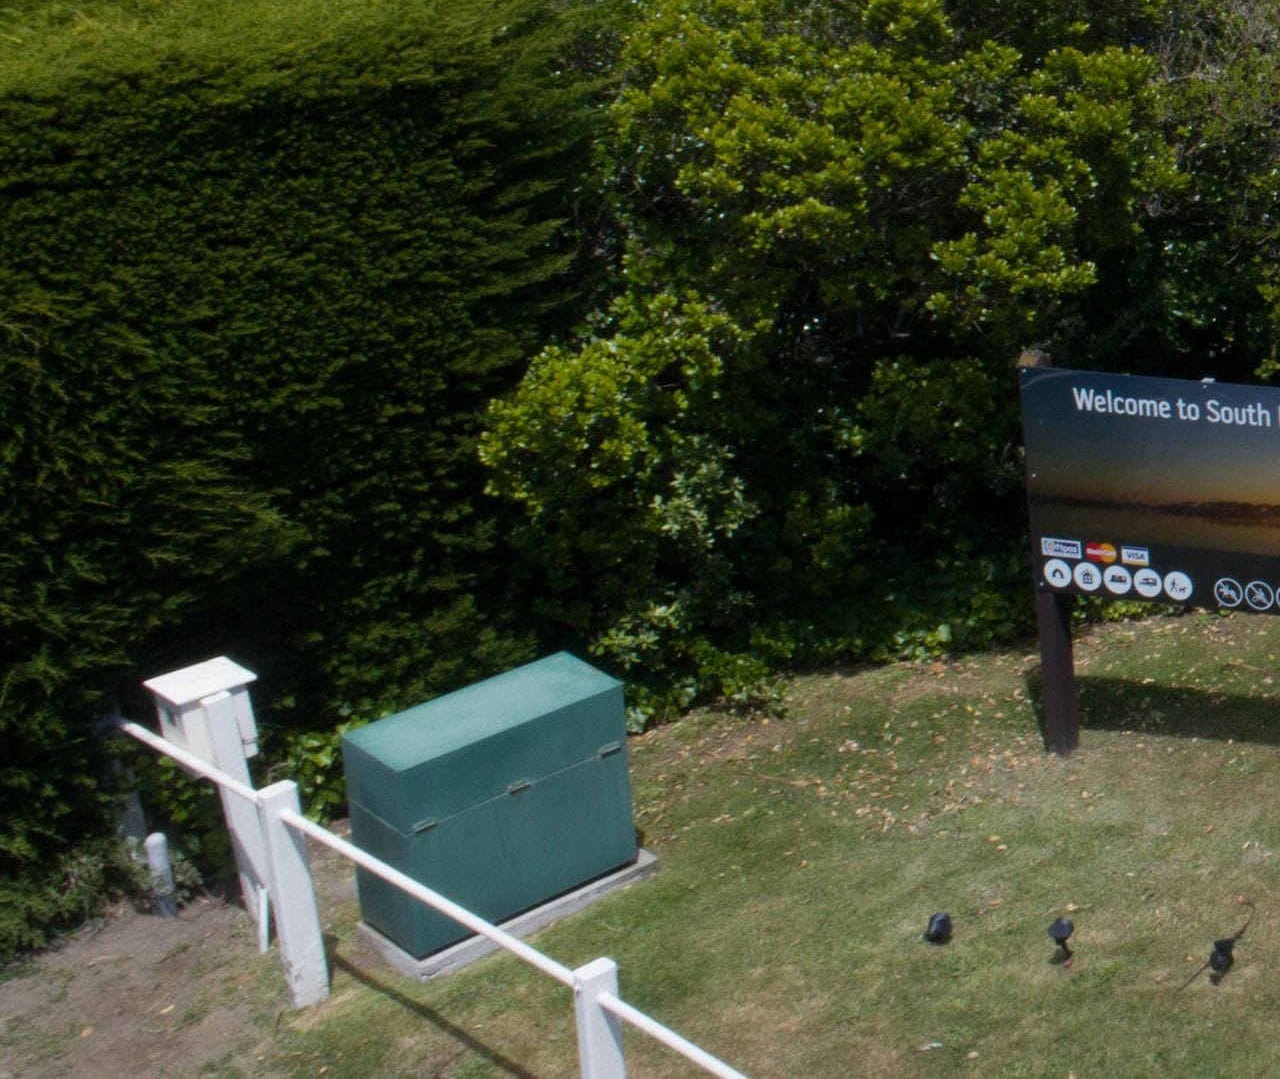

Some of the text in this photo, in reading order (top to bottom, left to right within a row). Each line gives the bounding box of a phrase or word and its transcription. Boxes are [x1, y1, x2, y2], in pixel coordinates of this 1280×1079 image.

[1072, 387, 1171, 419] Welcome
[1177, 398, 1200, 421] to
[1206, 399, 1271, 427] South
[1126, 552, 1145, 560] VISA
